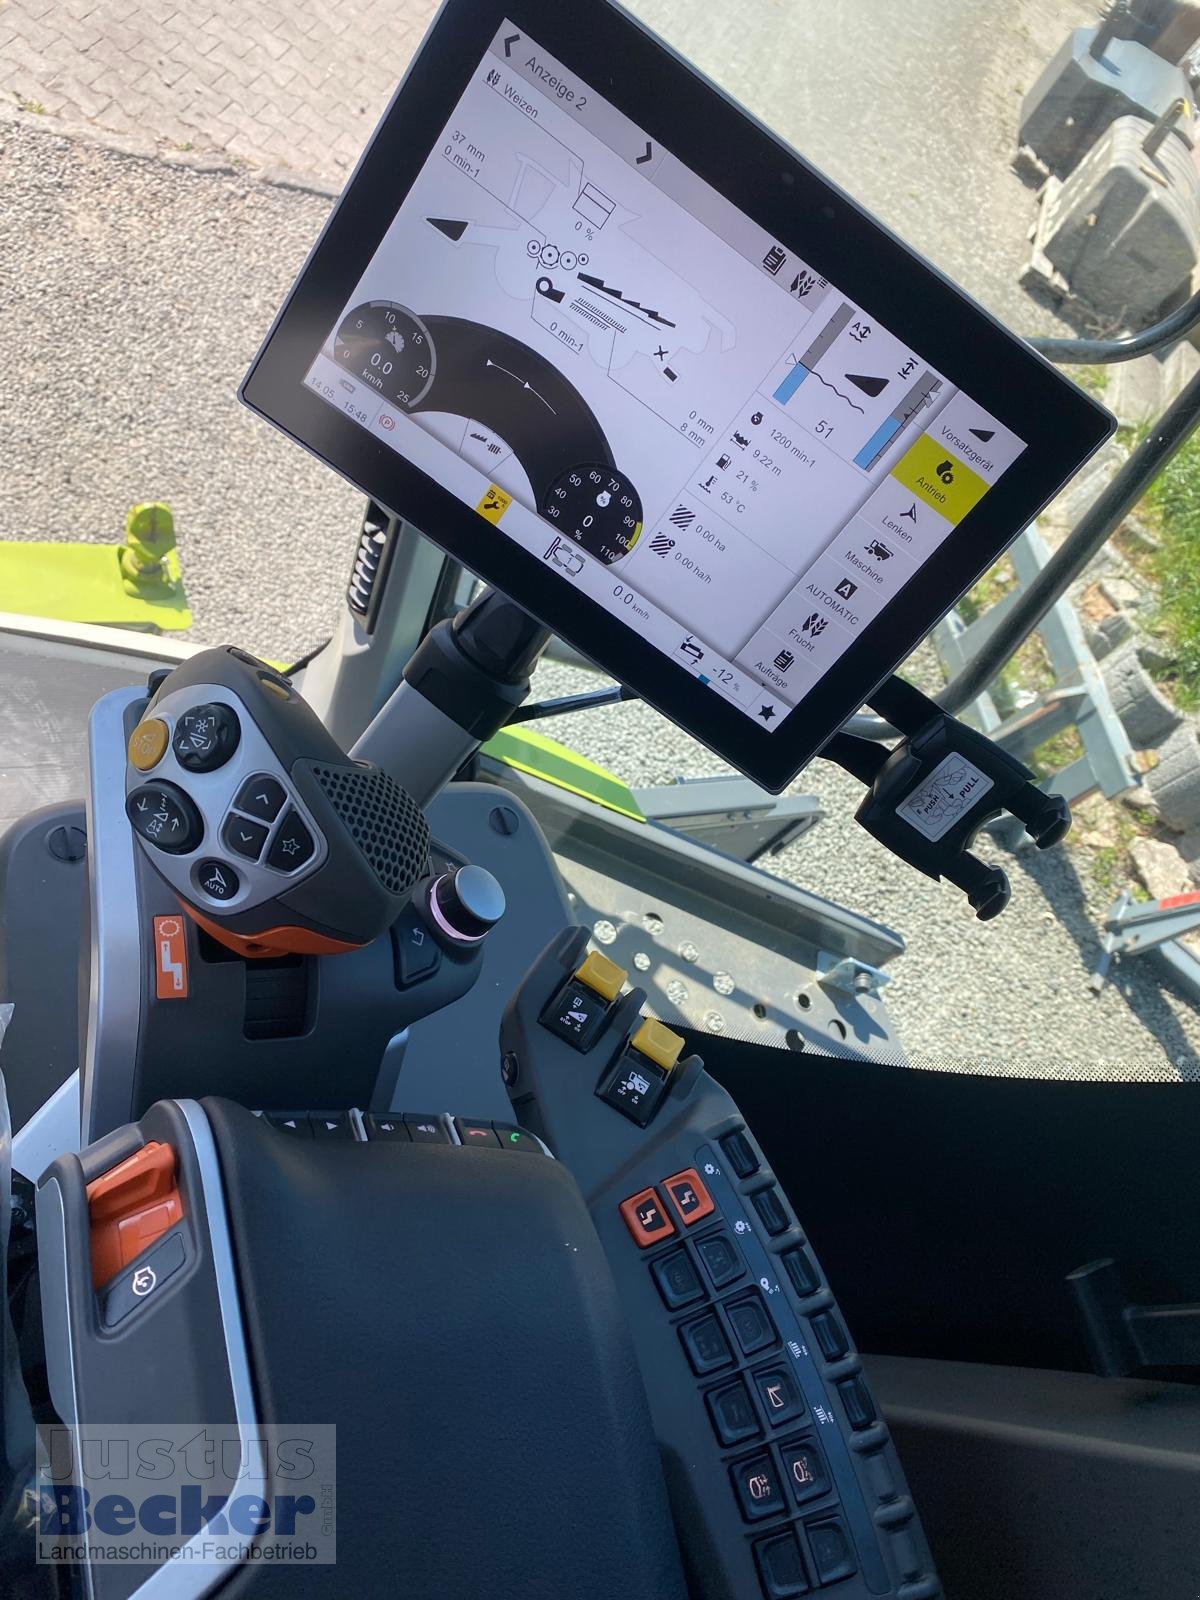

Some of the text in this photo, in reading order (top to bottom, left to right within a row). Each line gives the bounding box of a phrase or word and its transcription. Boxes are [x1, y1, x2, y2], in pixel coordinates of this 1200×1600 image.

[525, 56, 588, 111] Anzeige 2
[504, 84, 539, 119] Weizen
[452, 130, 486, 162] 37 mm
[444, 145, 481, 178] 0 min-1
[574, 221, 594, 241] 0 %
[356, 319, 364, 329] 5
[385, 311, 396, 324] 10
[411, 332, 423, 344] 15
[550, 322, 584, 352] 0 min-1
[343, 350, 350, 359] 0
[370, 353, 393, 375] 0.0
[362, 370, 384, 390] km/h
[416, 366, 428, 378] 20
[396, 390, 410, 403] 25
[343, 401, 367, 423] 15:48
[689, 410, 715, 435] 0 mm
[814, 420, 834, 440] 51
[680, 423, 706, 447] 8 mm
[770, 428, 816, 468] 1200 min-1
[941, 425, 994, 473] Vorsatzgerät
[752, 449, 782, 477] 9.22 m
[569, 474, 581, 487] 50
[589, 471, 601, 484] 60
[607, 478, 620, 491] 70
[736, 471, 758, 492] 21 %
[554, 487, 567, 500] 40
[720, 491, 733, 504] 53
[916, 476, 947, 504] Antrieb
[547, 505, 560, 518] 30
[620, 495, 633, 508] 80
[582, 515, 593, 527] 0
[623, 515, 635, 528] 90
[881, 516, 913, 543] Lenken
[574, 529, 582, 541] %
[614, 533, 630, 548] 100
[695, 525, 726, 552] 0.00 ha
[600, 545, 615, 560] 110
[675, 552, 712, 584] 0.00 ha/h
[845, 550, 884, 584] Maschine
[837, 581, 851, 596] A
[612, 585, 651, 621] 0.0 km/h
[805, 583, 859, 626] AUTOMATIC
[788, 628, 816, 653] Frucht
[712, 666, 734, 685] -12
[754, 660, 788, 690] Aufträge
[959, 777, 979, 798] PULL
[923, 794, 940, 814] PUSH
[204, 880, 224, 894] AUTO
